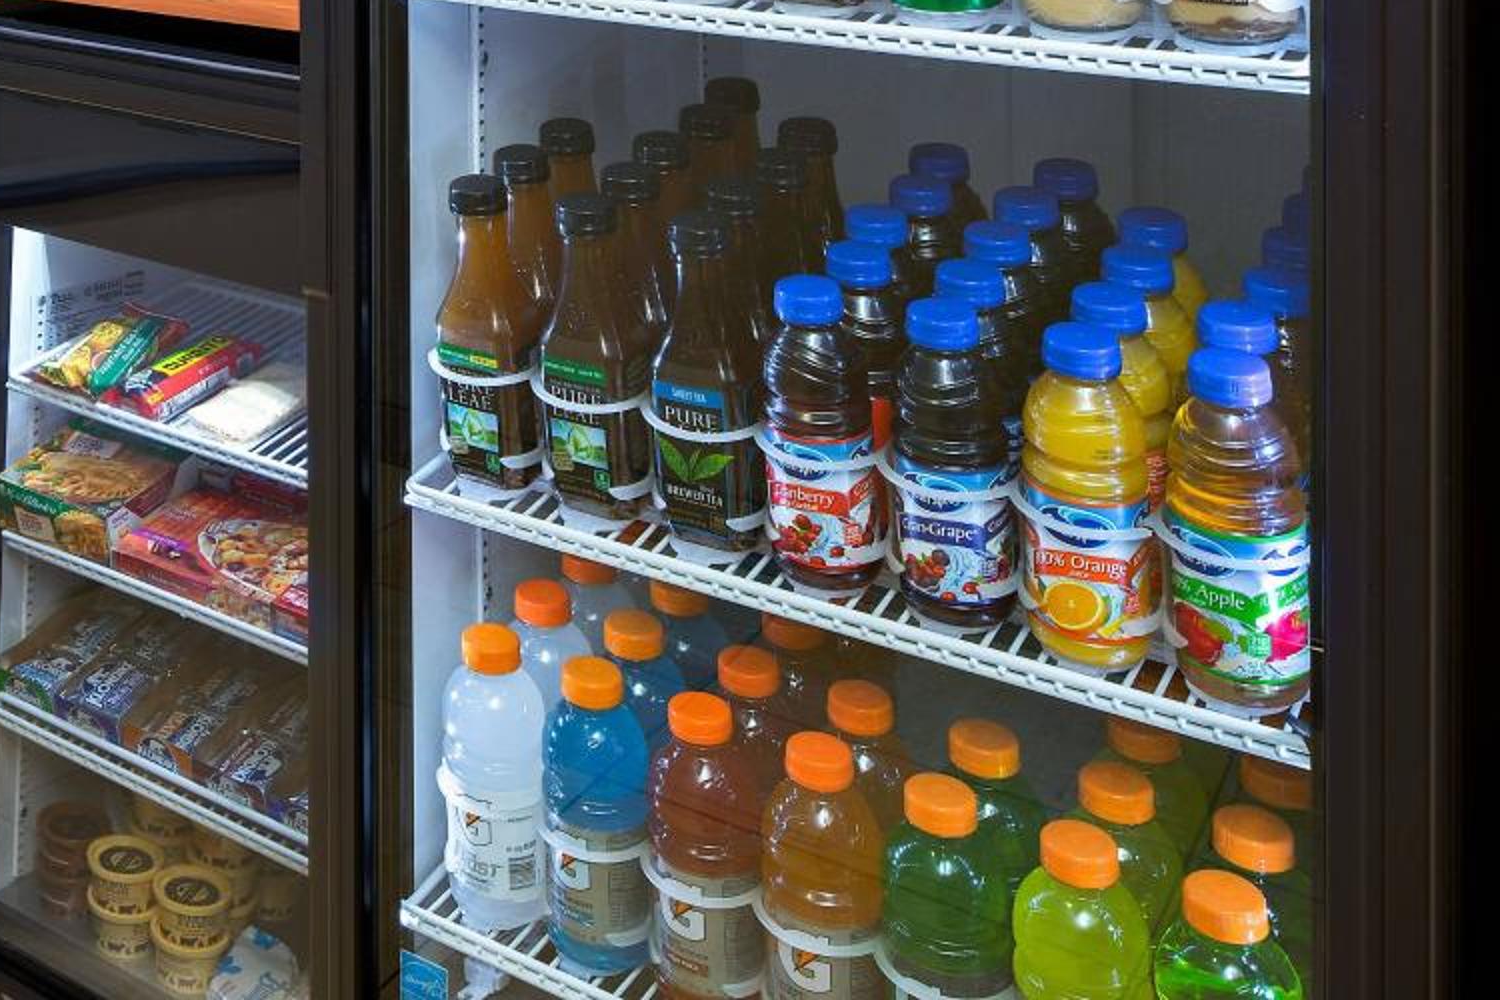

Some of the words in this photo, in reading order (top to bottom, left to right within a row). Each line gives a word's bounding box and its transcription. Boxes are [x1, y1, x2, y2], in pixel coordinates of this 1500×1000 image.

[665, 405, 717, 429] PURE
[1071, 555, 1128, 580] Orange
[1196, 584, 1245, 611] Apple
